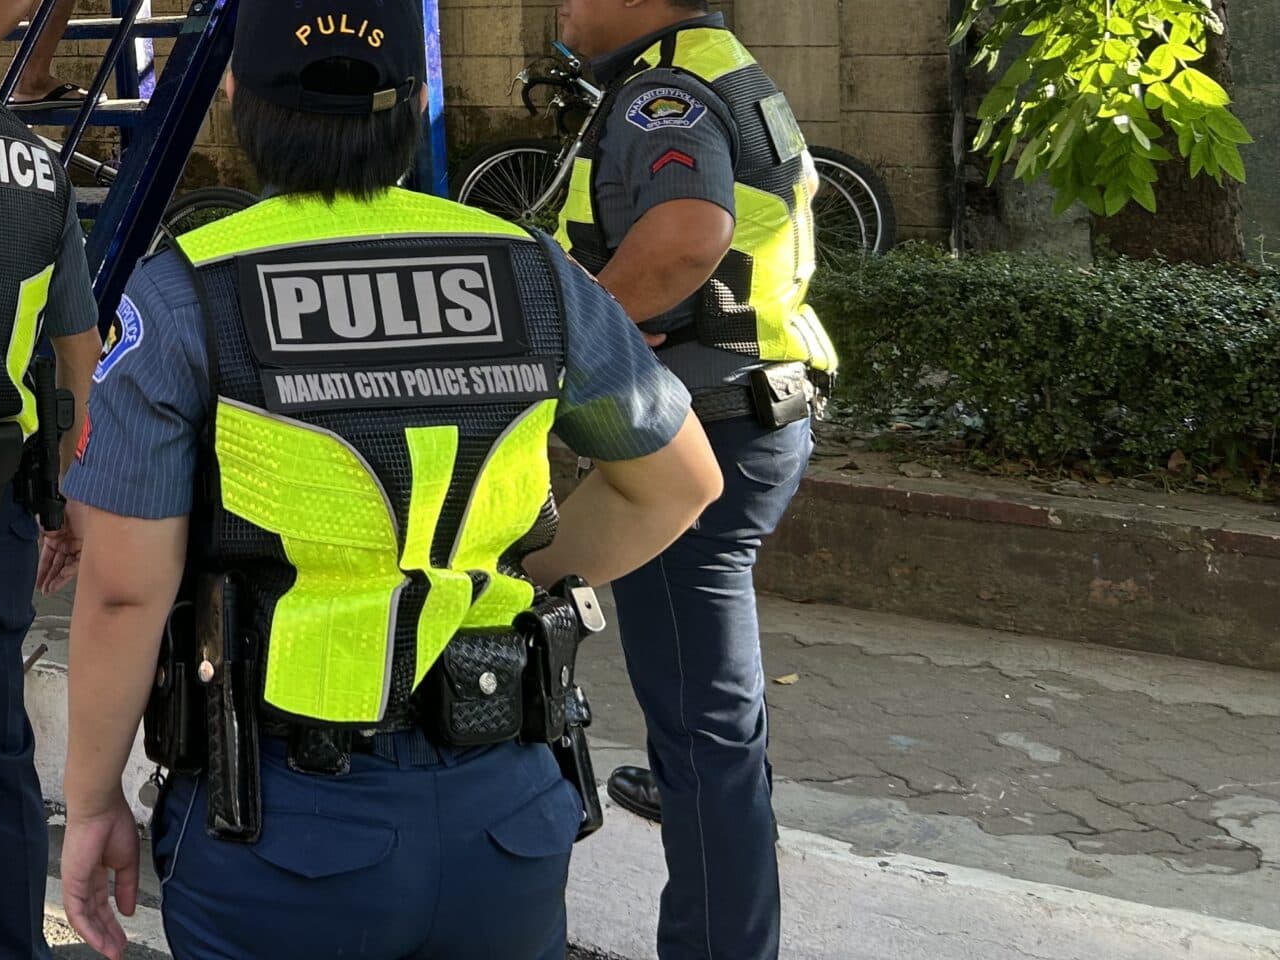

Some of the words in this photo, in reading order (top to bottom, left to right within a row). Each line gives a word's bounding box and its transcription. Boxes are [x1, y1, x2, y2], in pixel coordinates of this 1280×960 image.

[295, 13, 385, 47] PULIS
[271, 268, 492, 339] PULIS
[122, 305, 138, 343] POLICE
[275, 373, 355, 404] MAKATI
[354, 371, 401, 399] CITY
[400, 367, 471, 397] POLICE
[472, 363, 549, 394] STATION
